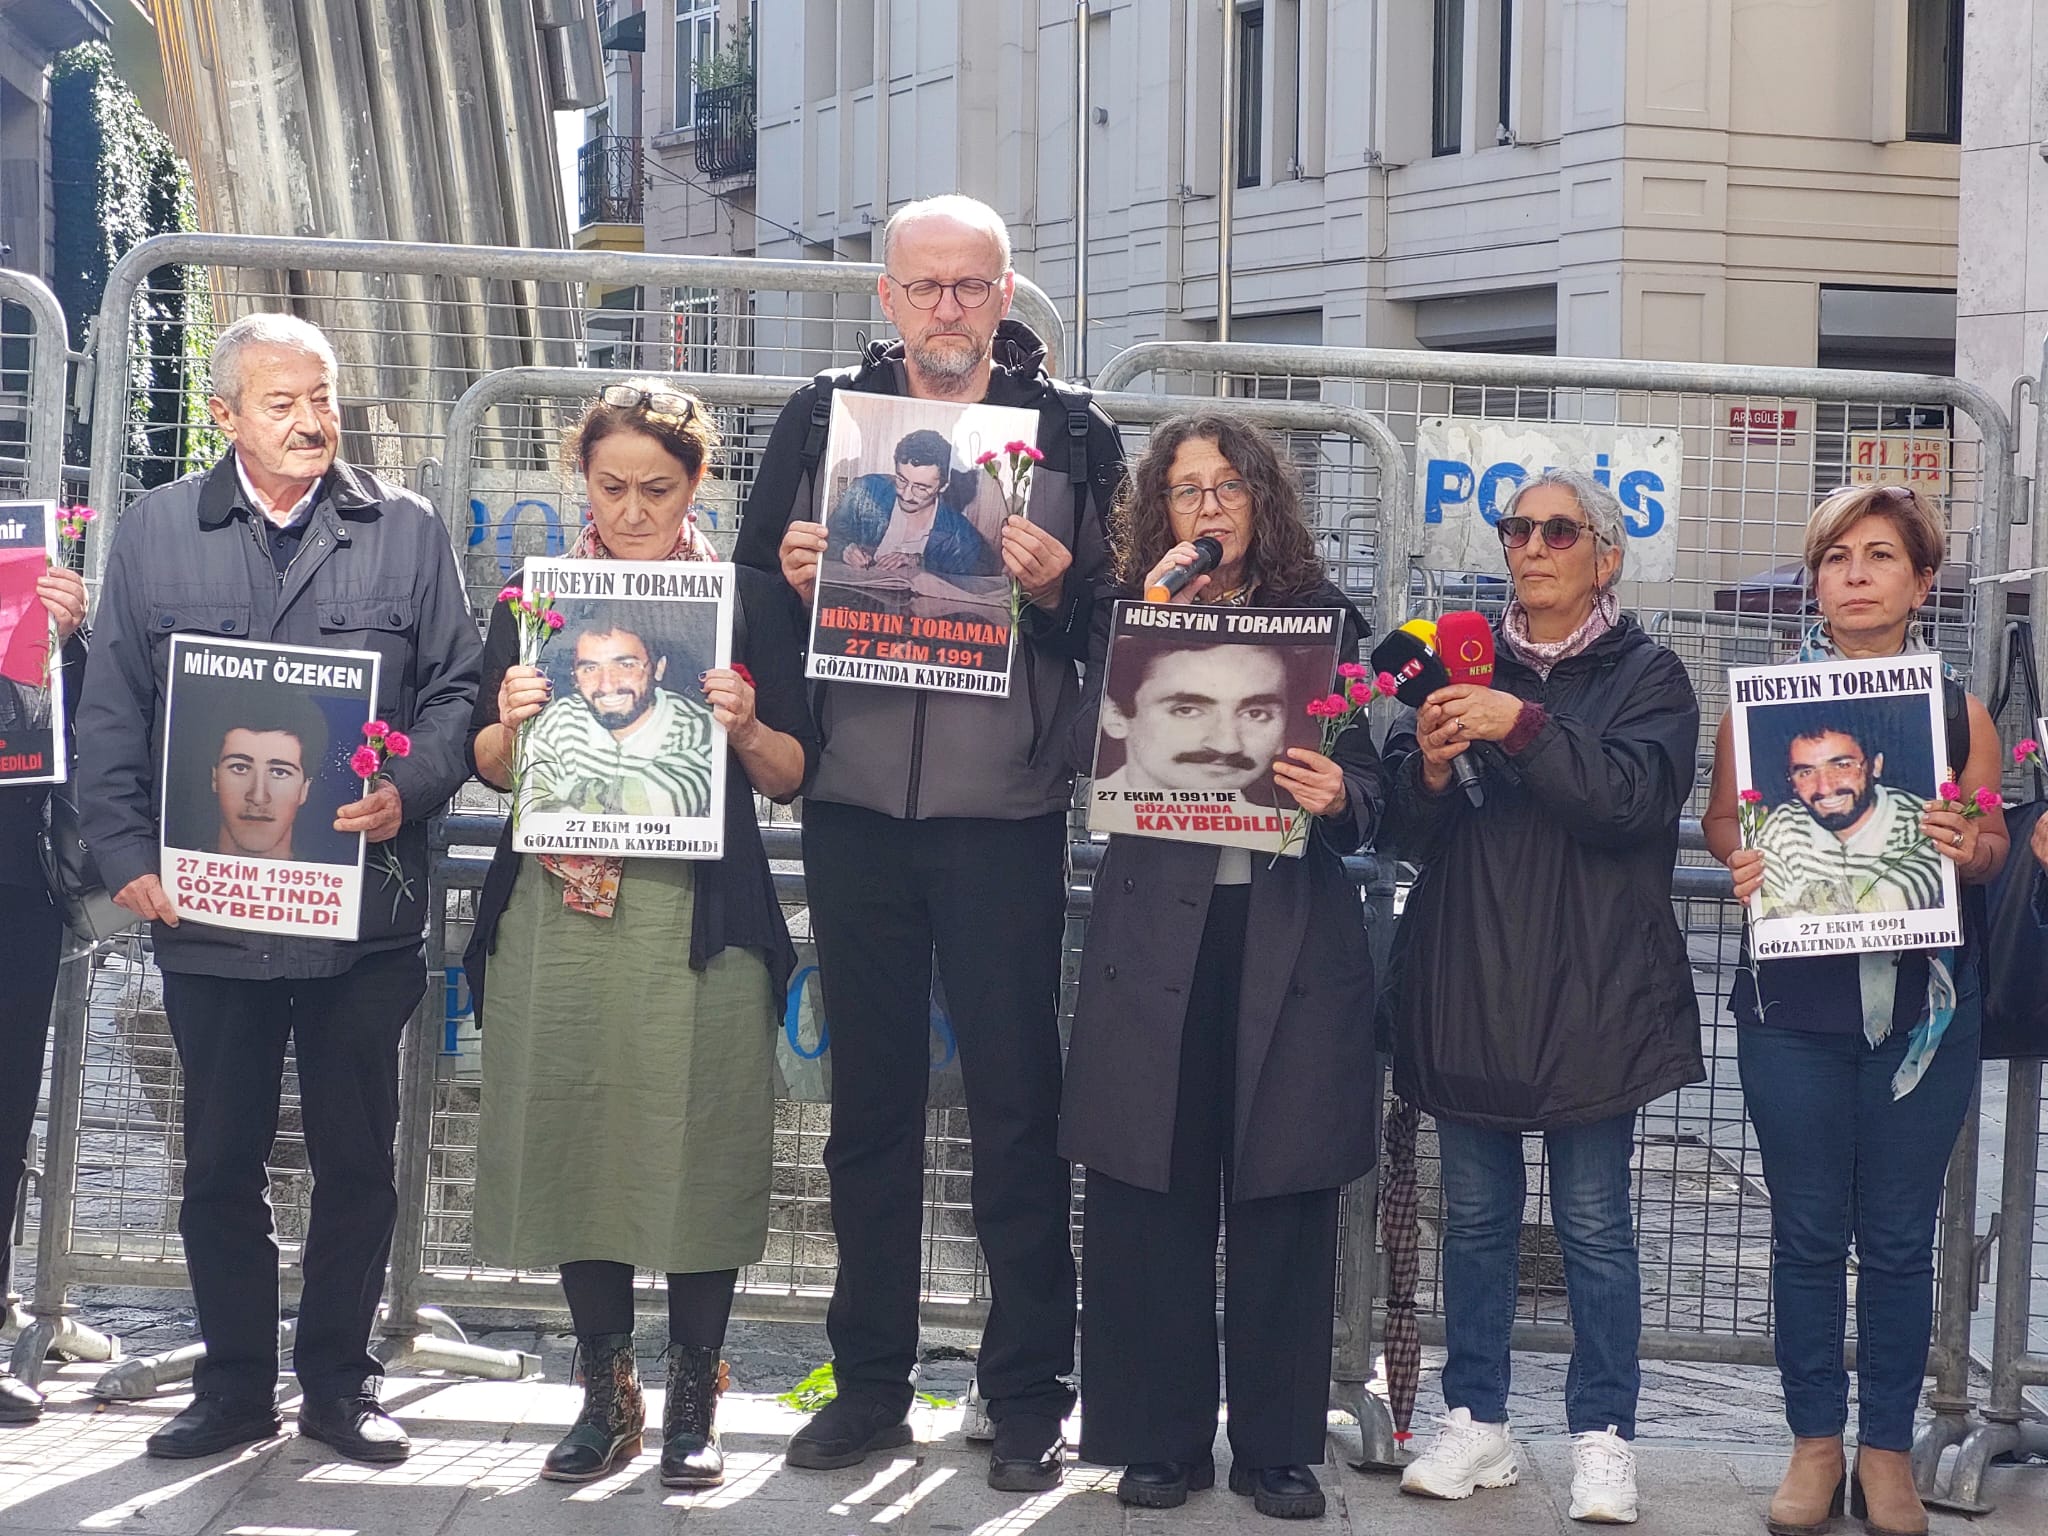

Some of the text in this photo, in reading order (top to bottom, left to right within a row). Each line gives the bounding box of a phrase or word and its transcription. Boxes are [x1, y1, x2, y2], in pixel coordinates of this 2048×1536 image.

[1754, 411, 1784, 424] GÜLER
[1424, 454, 1665, 538] POS
[622, 573, 724, 598] TORAMAN
[910, 616, 1008, 645] TORAMAN
[1226, 615, 1333, 634] TORAMAN
[845, 638, 983, 667] 27 EKİM 1991
[184, 649, 362, 690] MİKDAT ÖZEKEN
[815, 656, 910, 684] GÖZALTINDA
[1403, 659, 1421, 678] TV
[1470, 664, 1493, 676] NEWS
[1828, 666, 1933, 696] TORAMAN
[0, 751, 42, 771] EDİLDİ
[1097, 791, 1118, 800] 27
[1134, 803, 1232, 814] GÖZALTINDA
[565, 820, 585, 832] 27
[635, 822, 672, 834] 1991
[524, 834, 619, 850] GÖZALTINDA
[176, 857, 199, 874] 27
[206, 861, 258, 881] EKİM
[176, 875, 342, 907] GÖZALTINDA
[1800, 923, 1820, 936] 27
[1870, 918, 1906, 932] 1991
[1759, 939, 1856, 955] GÖZALTINDA
